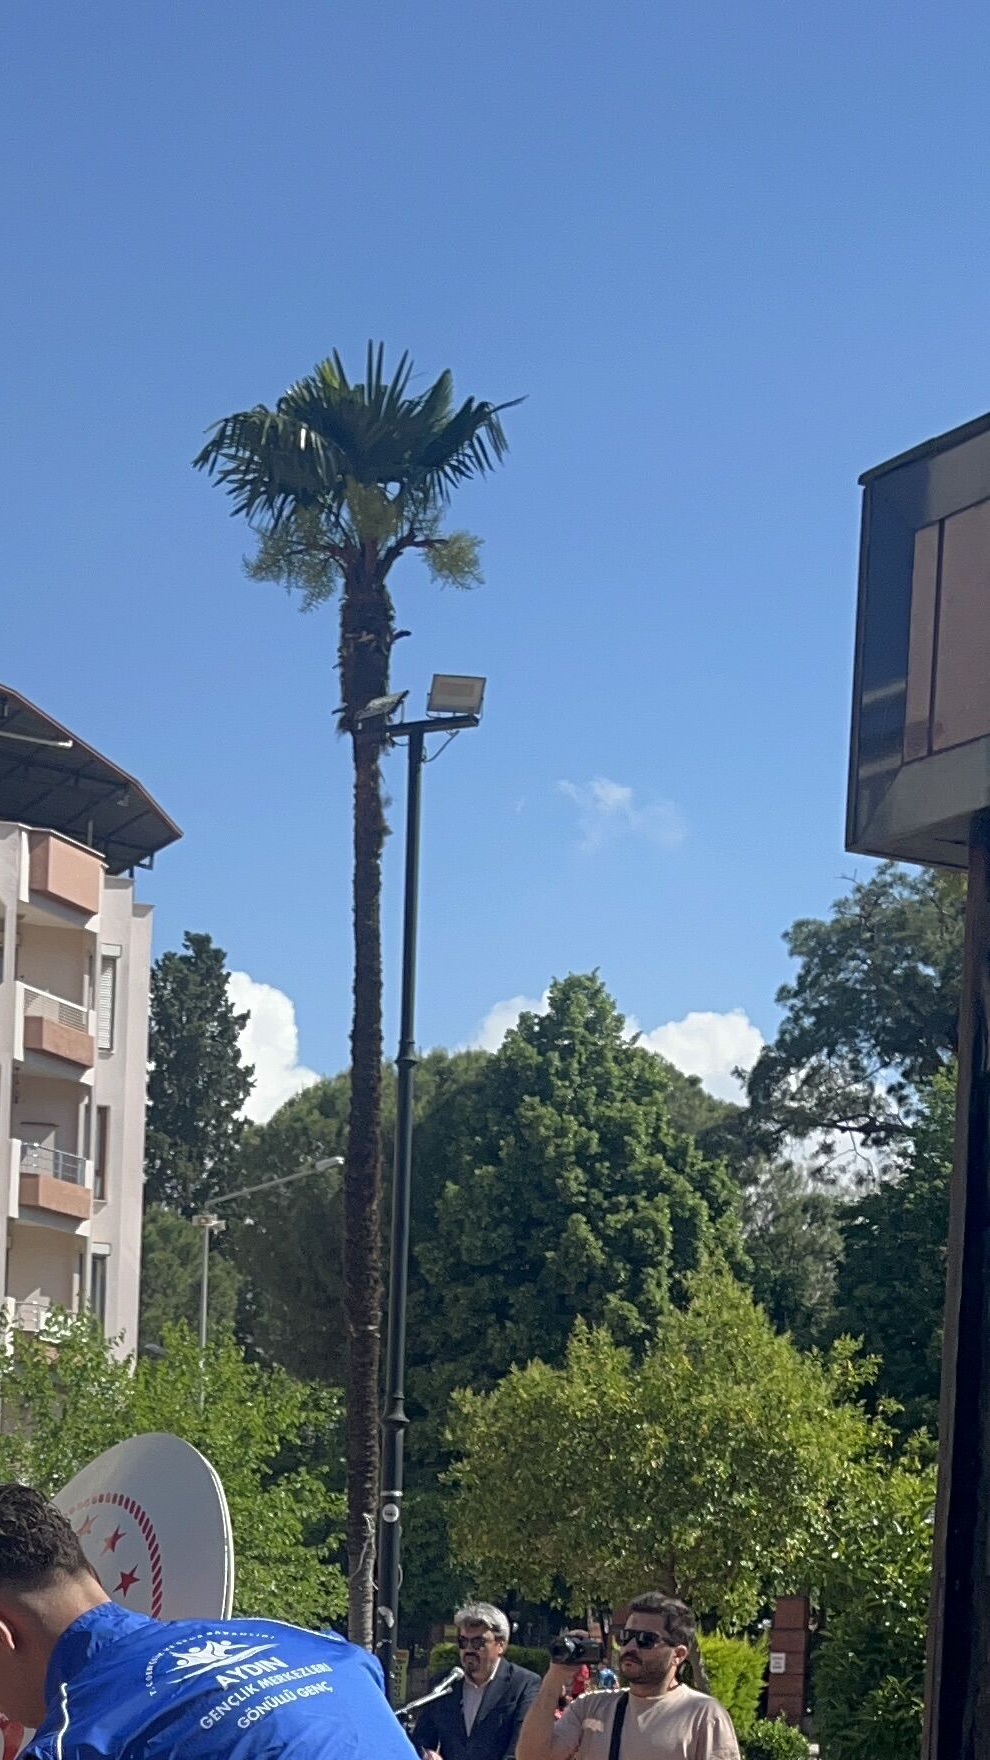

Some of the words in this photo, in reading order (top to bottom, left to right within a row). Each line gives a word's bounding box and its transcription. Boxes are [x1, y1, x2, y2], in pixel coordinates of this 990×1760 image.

[215, 1656, 289, 1691] AYDIN
[200, 1683, 260, 1730] GENÇLİK
[237, 1690, 298, 1729] GÖNÜLLÜ
[296, 1681, 334, 1699] GENÇ
